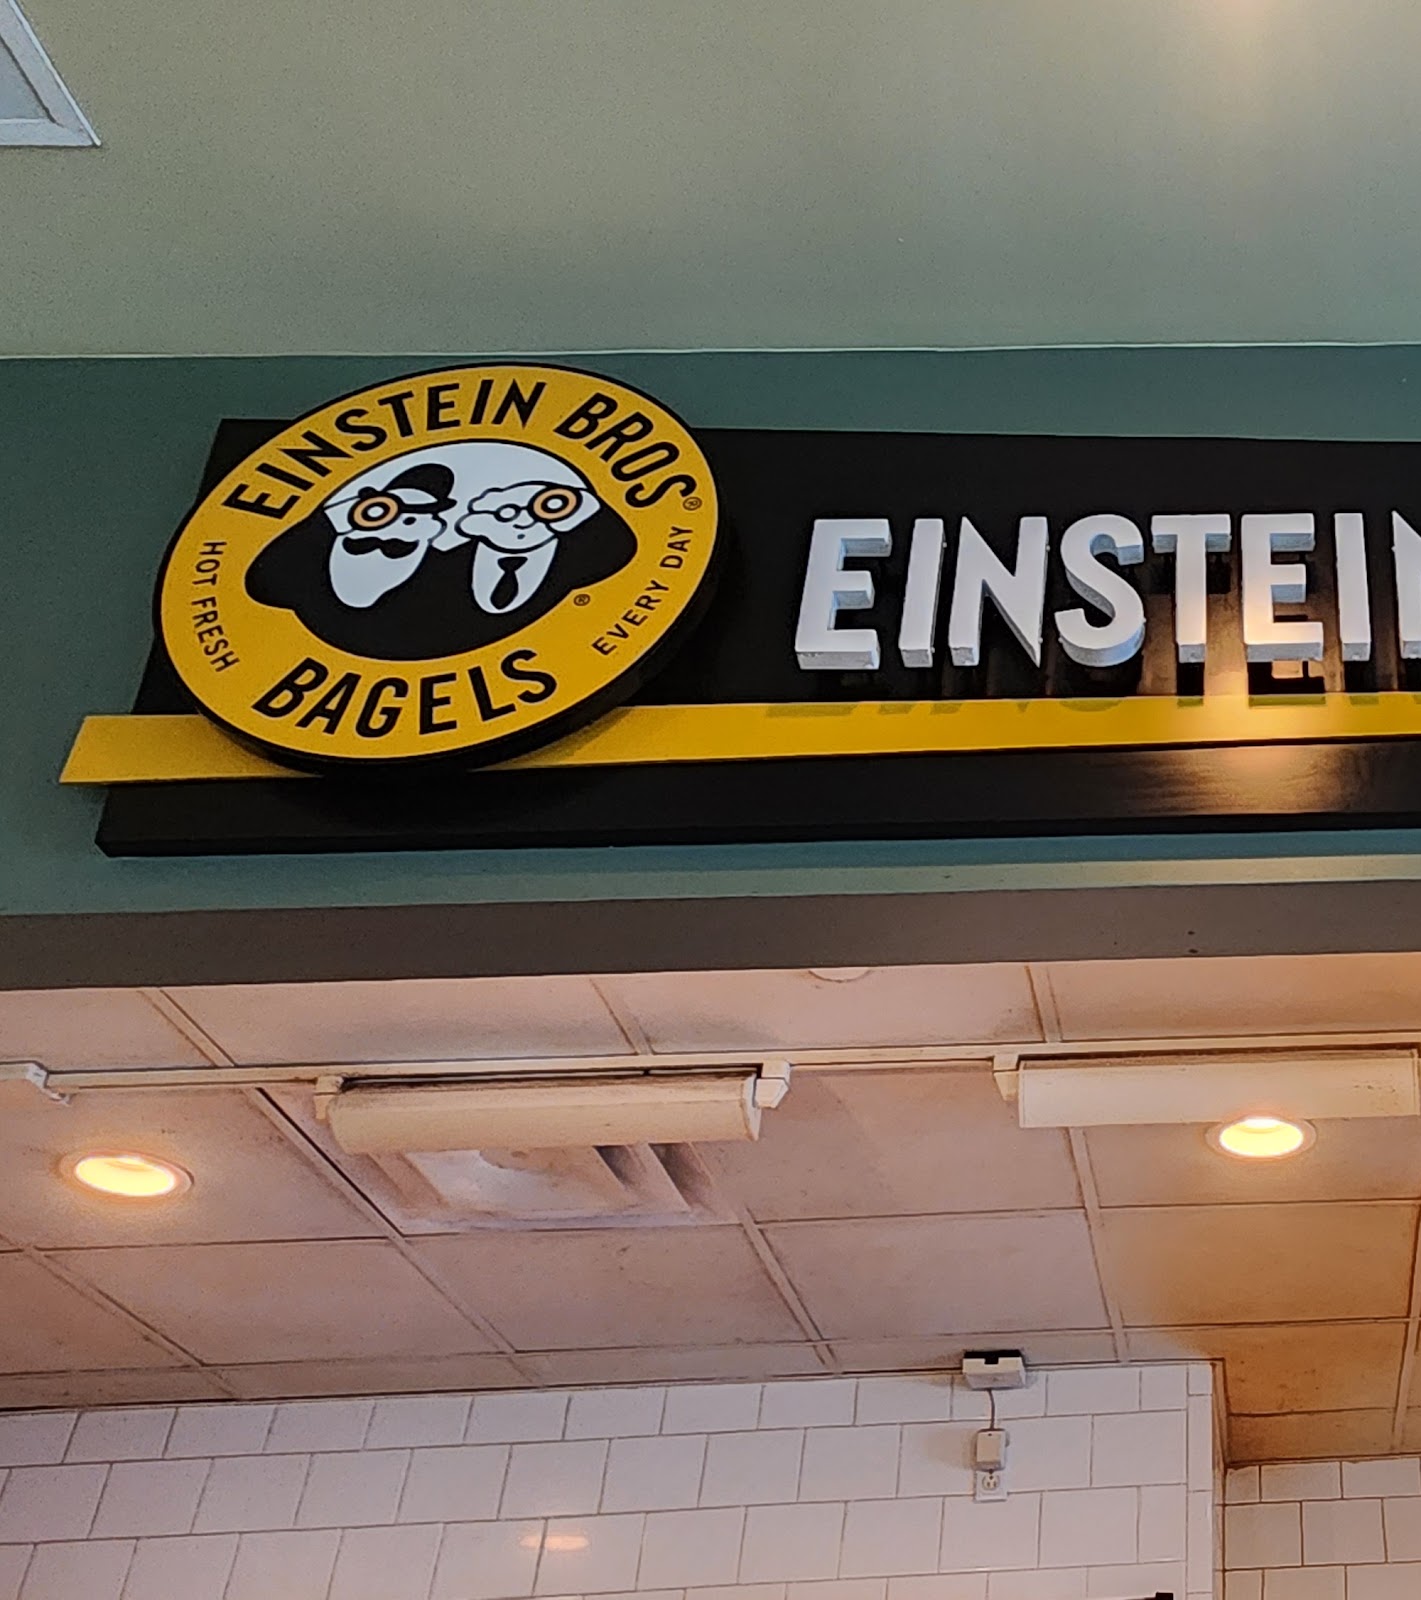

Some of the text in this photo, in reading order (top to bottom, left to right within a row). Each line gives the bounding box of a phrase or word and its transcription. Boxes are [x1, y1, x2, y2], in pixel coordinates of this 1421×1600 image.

[221, 378, 547, 520] EINSTEIN
[192, 540, 240, 673] HOT FRESH
[591, 524, 694, 656] EVERY DAY
[251, 649, 558, 738] BAGELS
